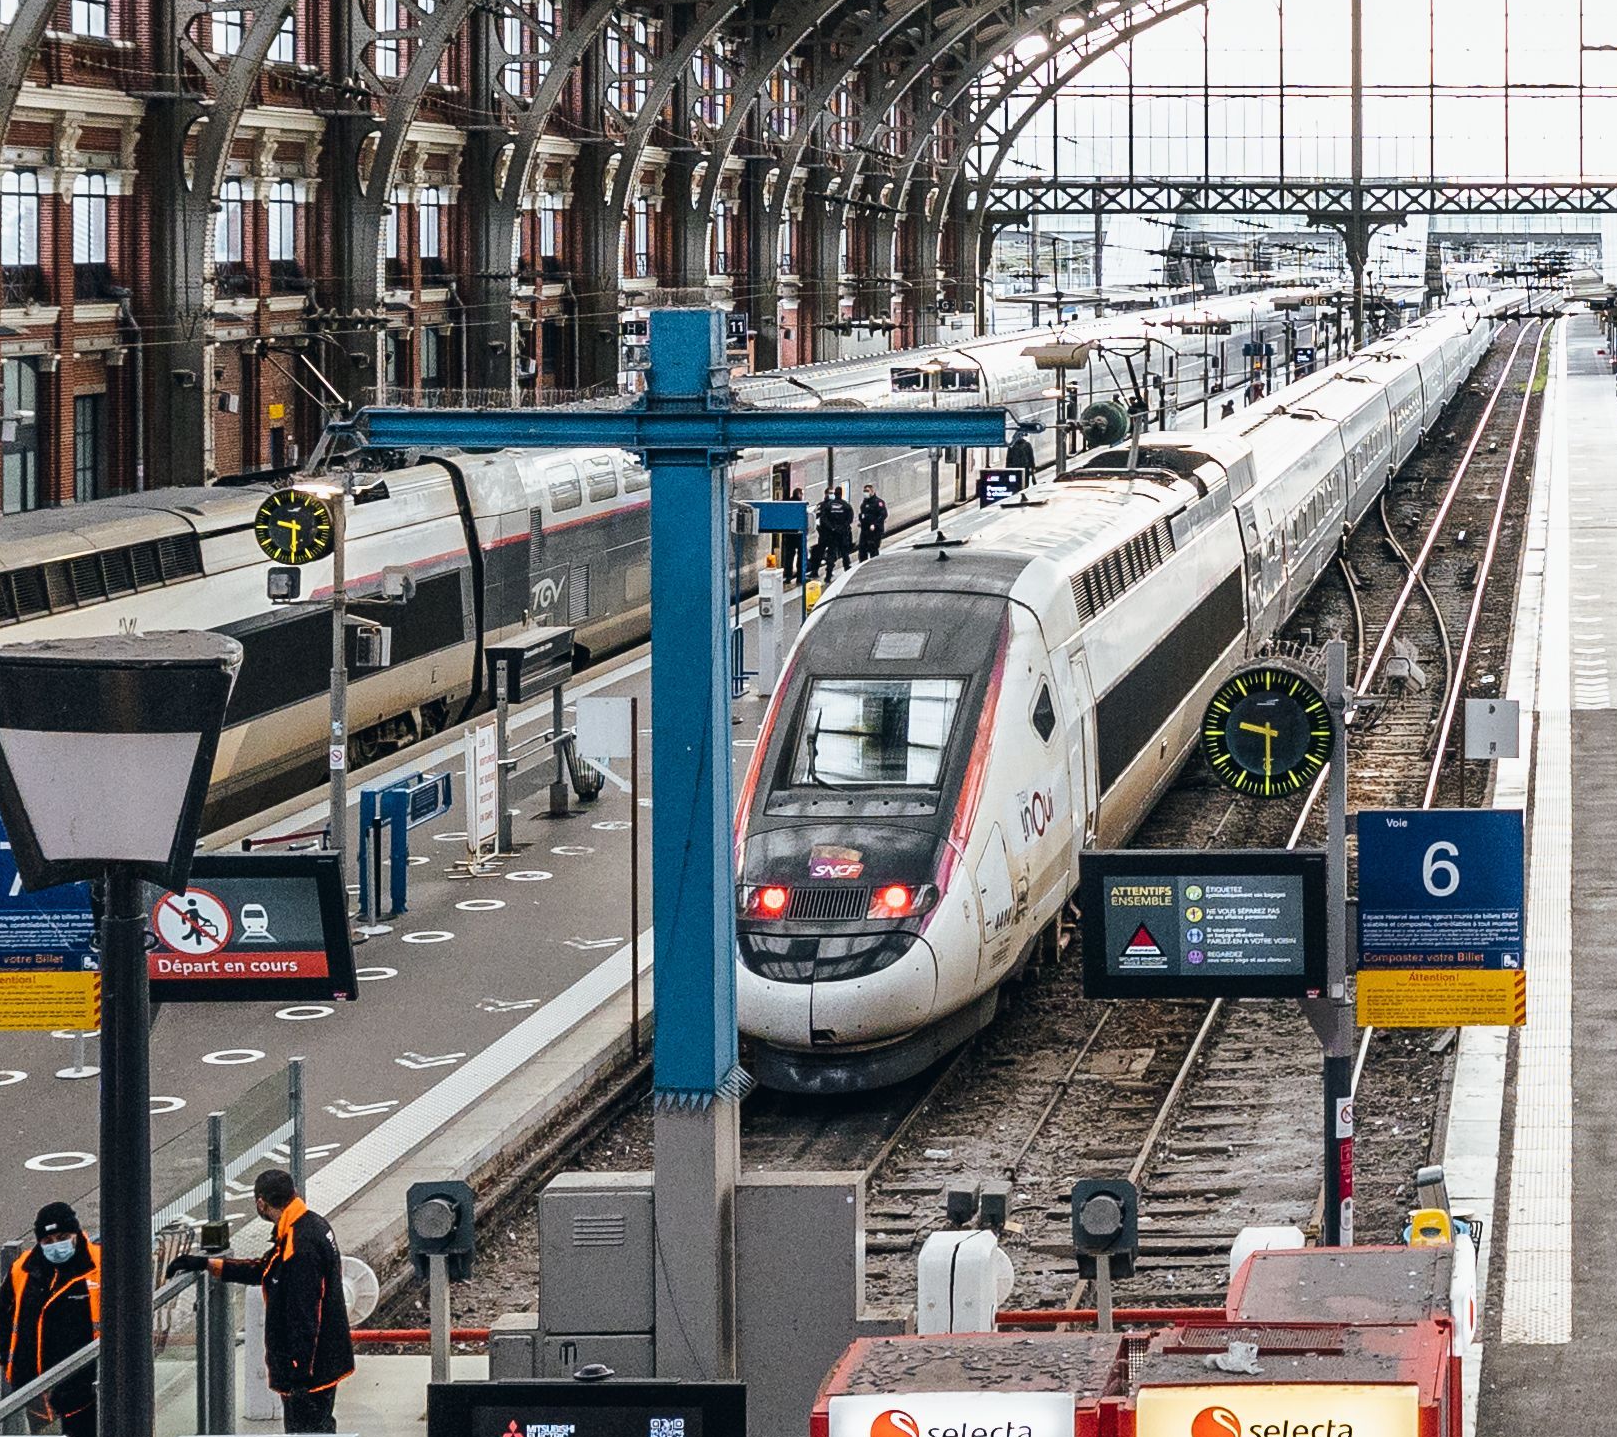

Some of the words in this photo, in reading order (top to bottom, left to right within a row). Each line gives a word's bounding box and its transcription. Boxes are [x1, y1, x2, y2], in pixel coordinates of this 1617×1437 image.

[730, 322, 744, 333] 11
[533, 575, 567, 611] TGV
[1386, 818, 1408, 828] Voie
[812, 864, 860, 876] SNCF
[1422, 841, 1460, 897] 6
[1110, 886, 1173, 896] ATTENTIFS
[1110, 896, 1173, 906] ENSEMBLE
[3, 955, 33, 964] votre
[35, 954, 65, 964] Billet
[1363, 952, 1424, 965] Compostez
[1426, 953, 1455, 963] votre
[1457, 951, 1485, 962] Billet
[158, 958, 220, 976] Départ
[224, 962, 245, 973] en
[254, 959, 298, 973] cours
[1408, 972, 1460, 982] Attention!
[526, 1424, 576, 1434] MITSUBISHI
